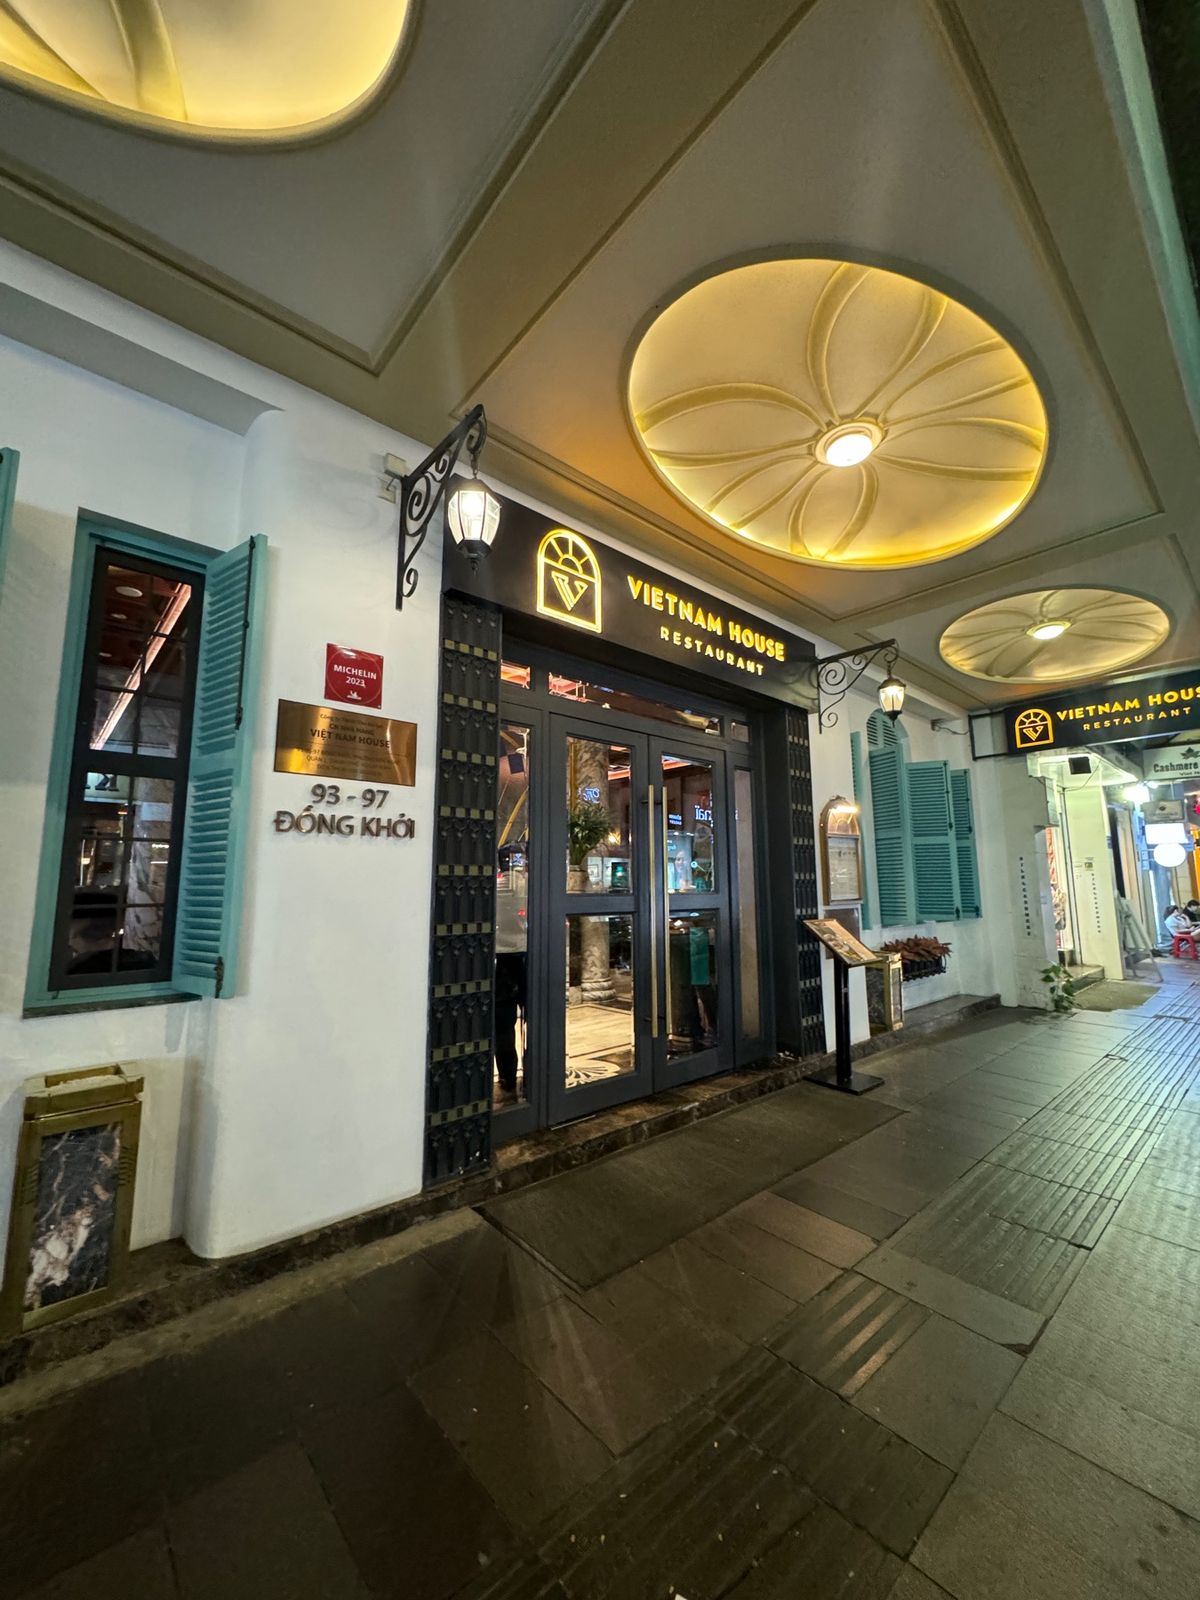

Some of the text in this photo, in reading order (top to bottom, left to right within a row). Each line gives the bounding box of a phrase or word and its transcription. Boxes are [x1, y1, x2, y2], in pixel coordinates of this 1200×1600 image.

[627, 575, 786, 662] VIETNAM HOUSE
[660, 625, 765, 676] RESTAURANT
[333, 664, 377, 680] MICHELIN
[1056, 697, 1141, 721] VIETNAM
[1083, 706, 1192, 731] RESTAURANT
[310, 728, 333, 741] VIỆT
[358, 735, 391, 749] HOUSE
[311, 783, 341, 805] 93
[361, 788, 390, 809] 97
